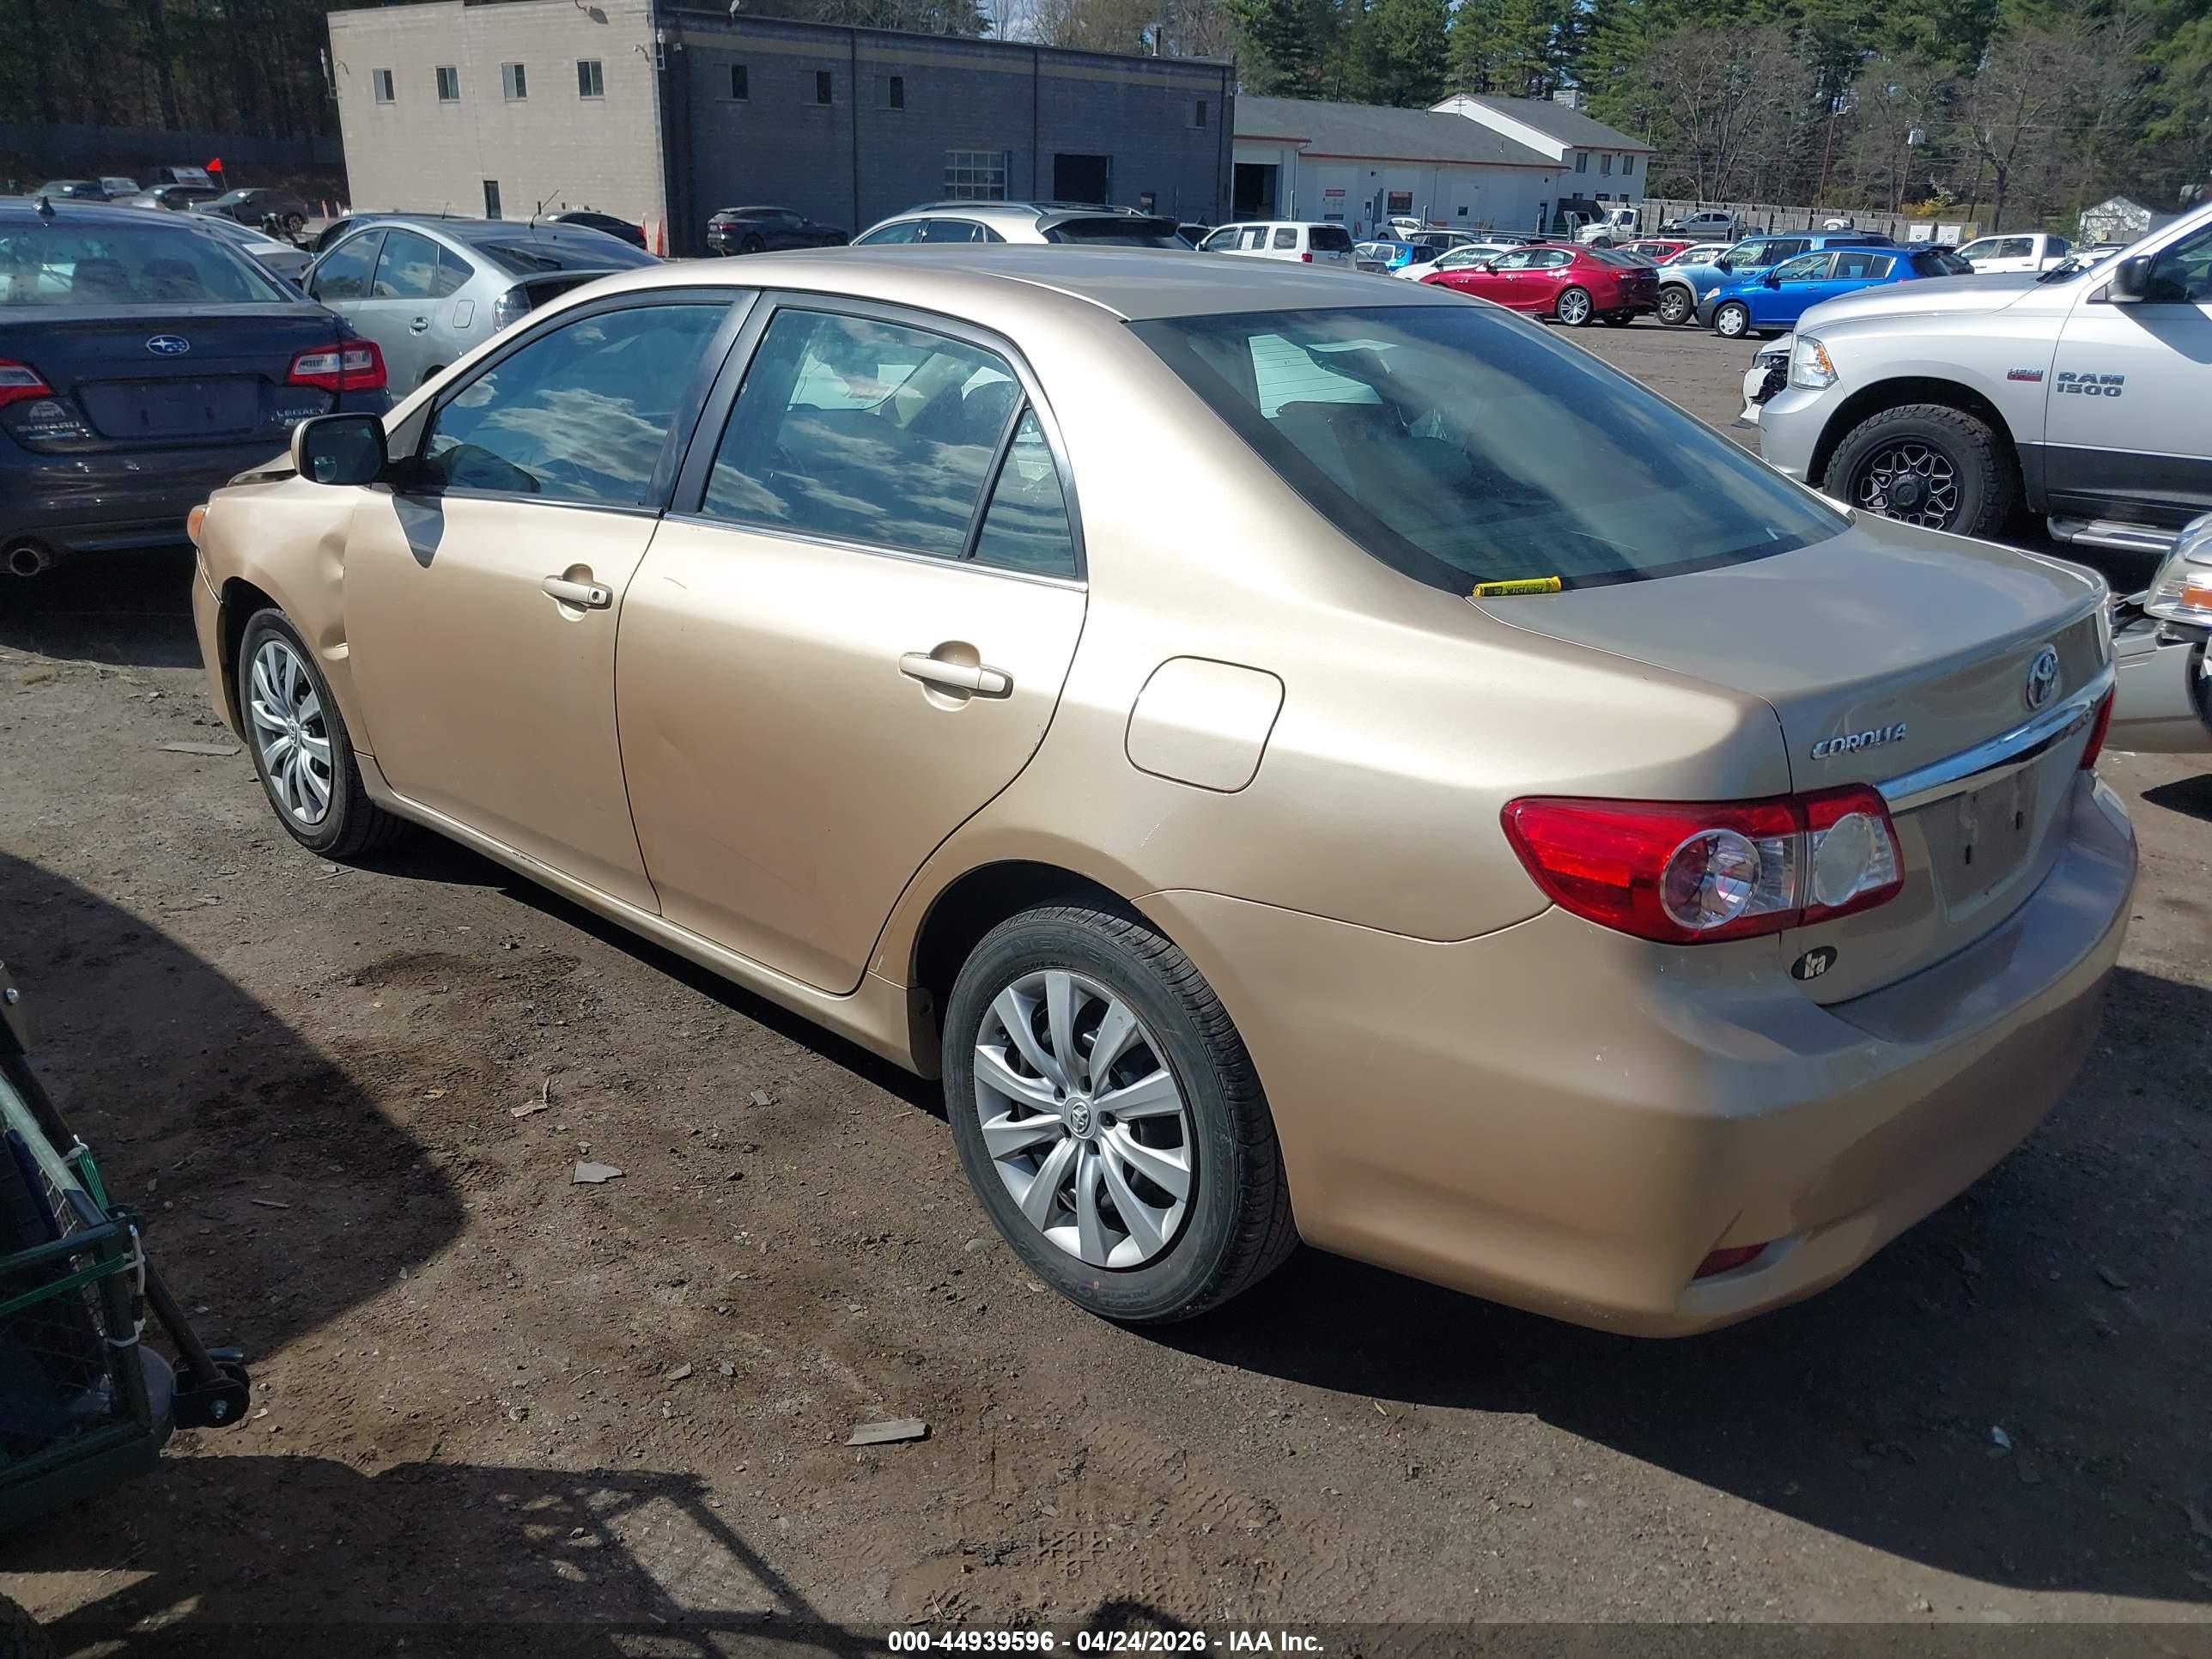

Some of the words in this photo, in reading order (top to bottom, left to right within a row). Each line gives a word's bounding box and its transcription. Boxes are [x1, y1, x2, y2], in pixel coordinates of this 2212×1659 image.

[2057, 372, 2124, 386] RAM
[2057, 383, 2122, 397] 1500
[1811, 723, 1906, 760] COROLLA
[1804, 953, 1826, 978] Ira
